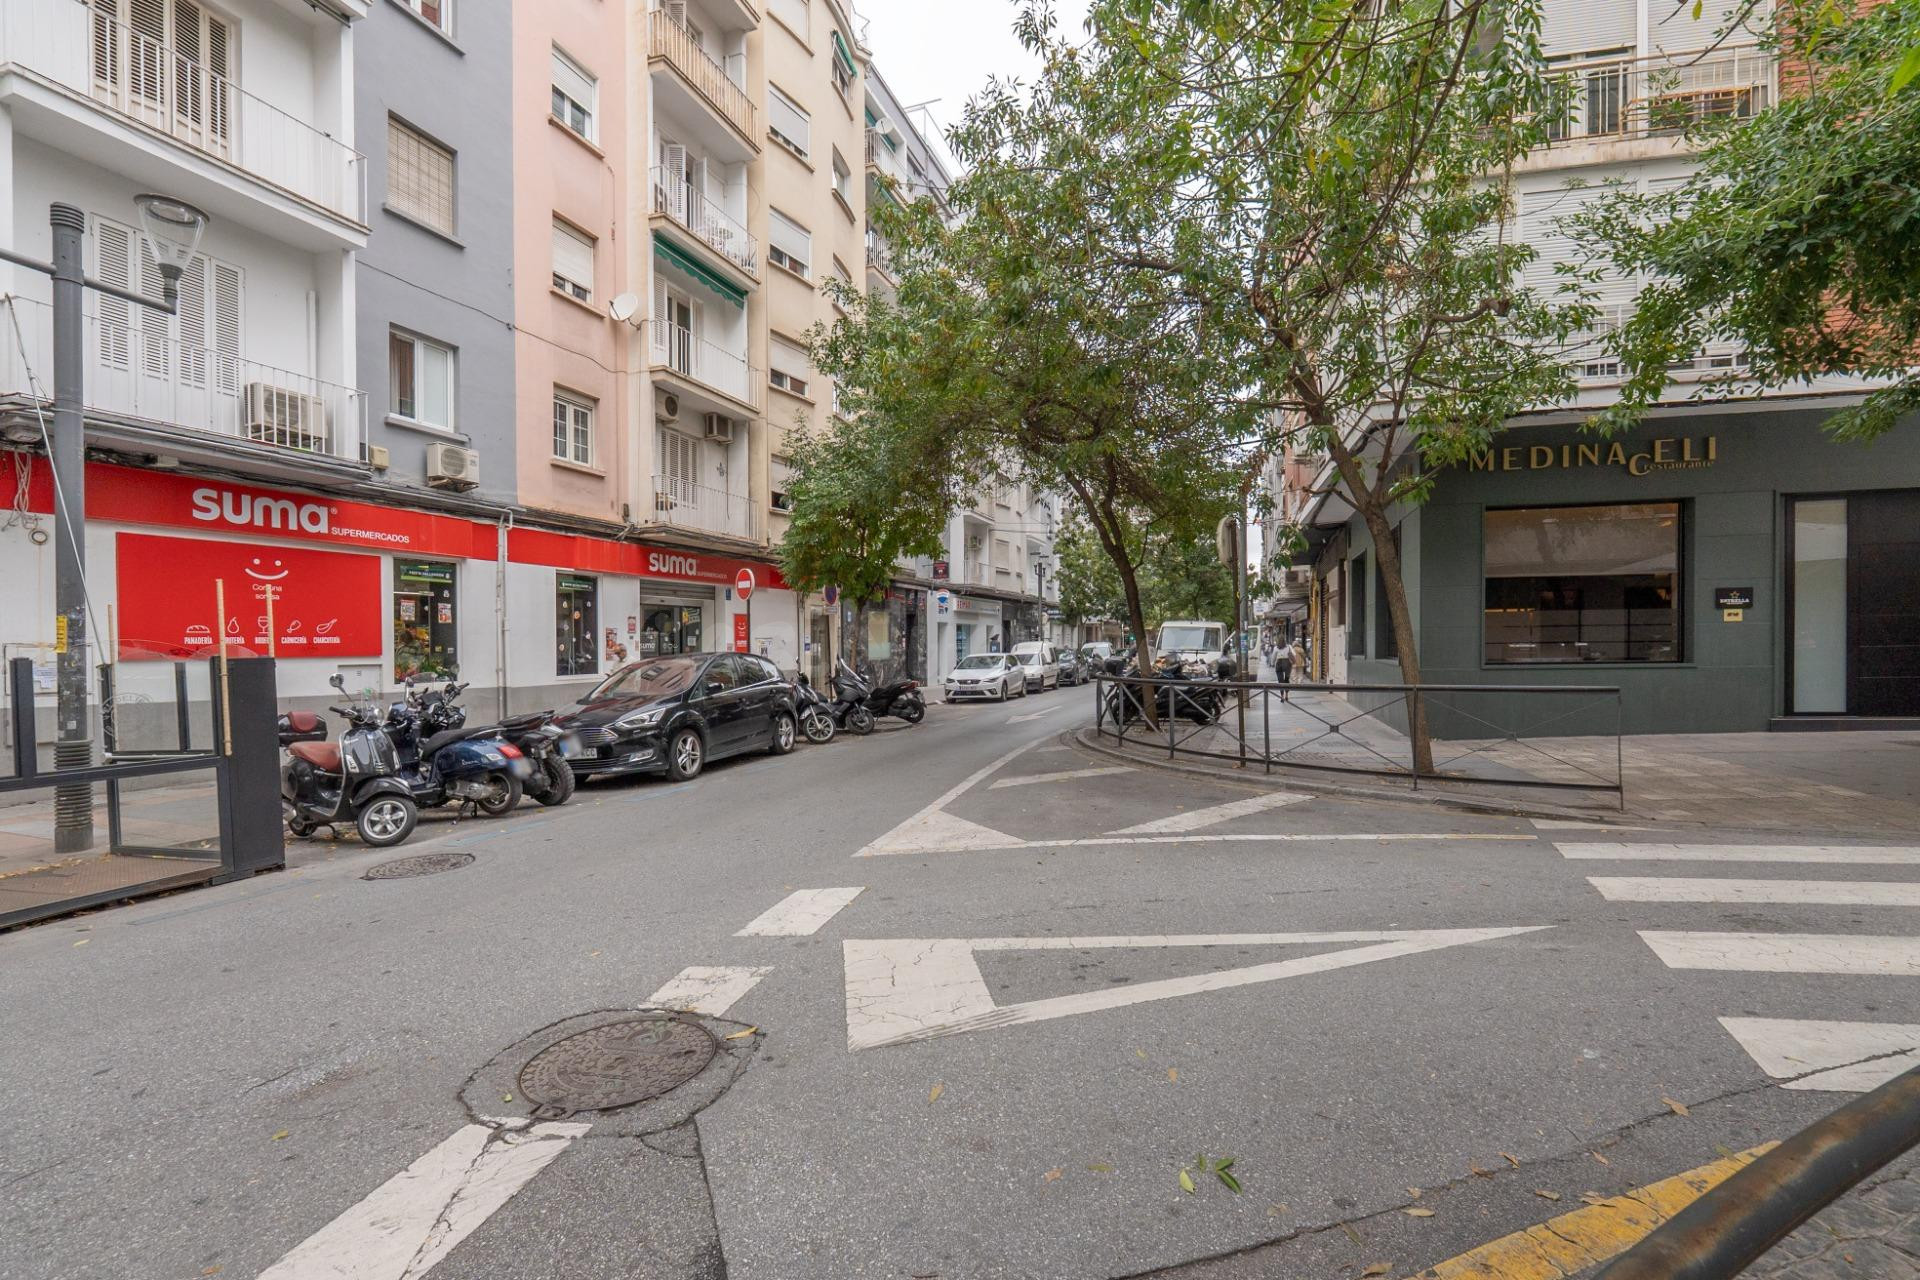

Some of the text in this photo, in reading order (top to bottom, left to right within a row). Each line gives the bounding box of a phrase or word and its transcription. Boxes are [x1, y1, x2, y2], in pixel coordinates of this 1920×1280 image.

[1643, 459, 1714, 472] restaurante
[191, 488, 329, 535] suma
[331, 526, 410, 544] SUPERMERCADOS
[648, 552, 697, 577] suma
